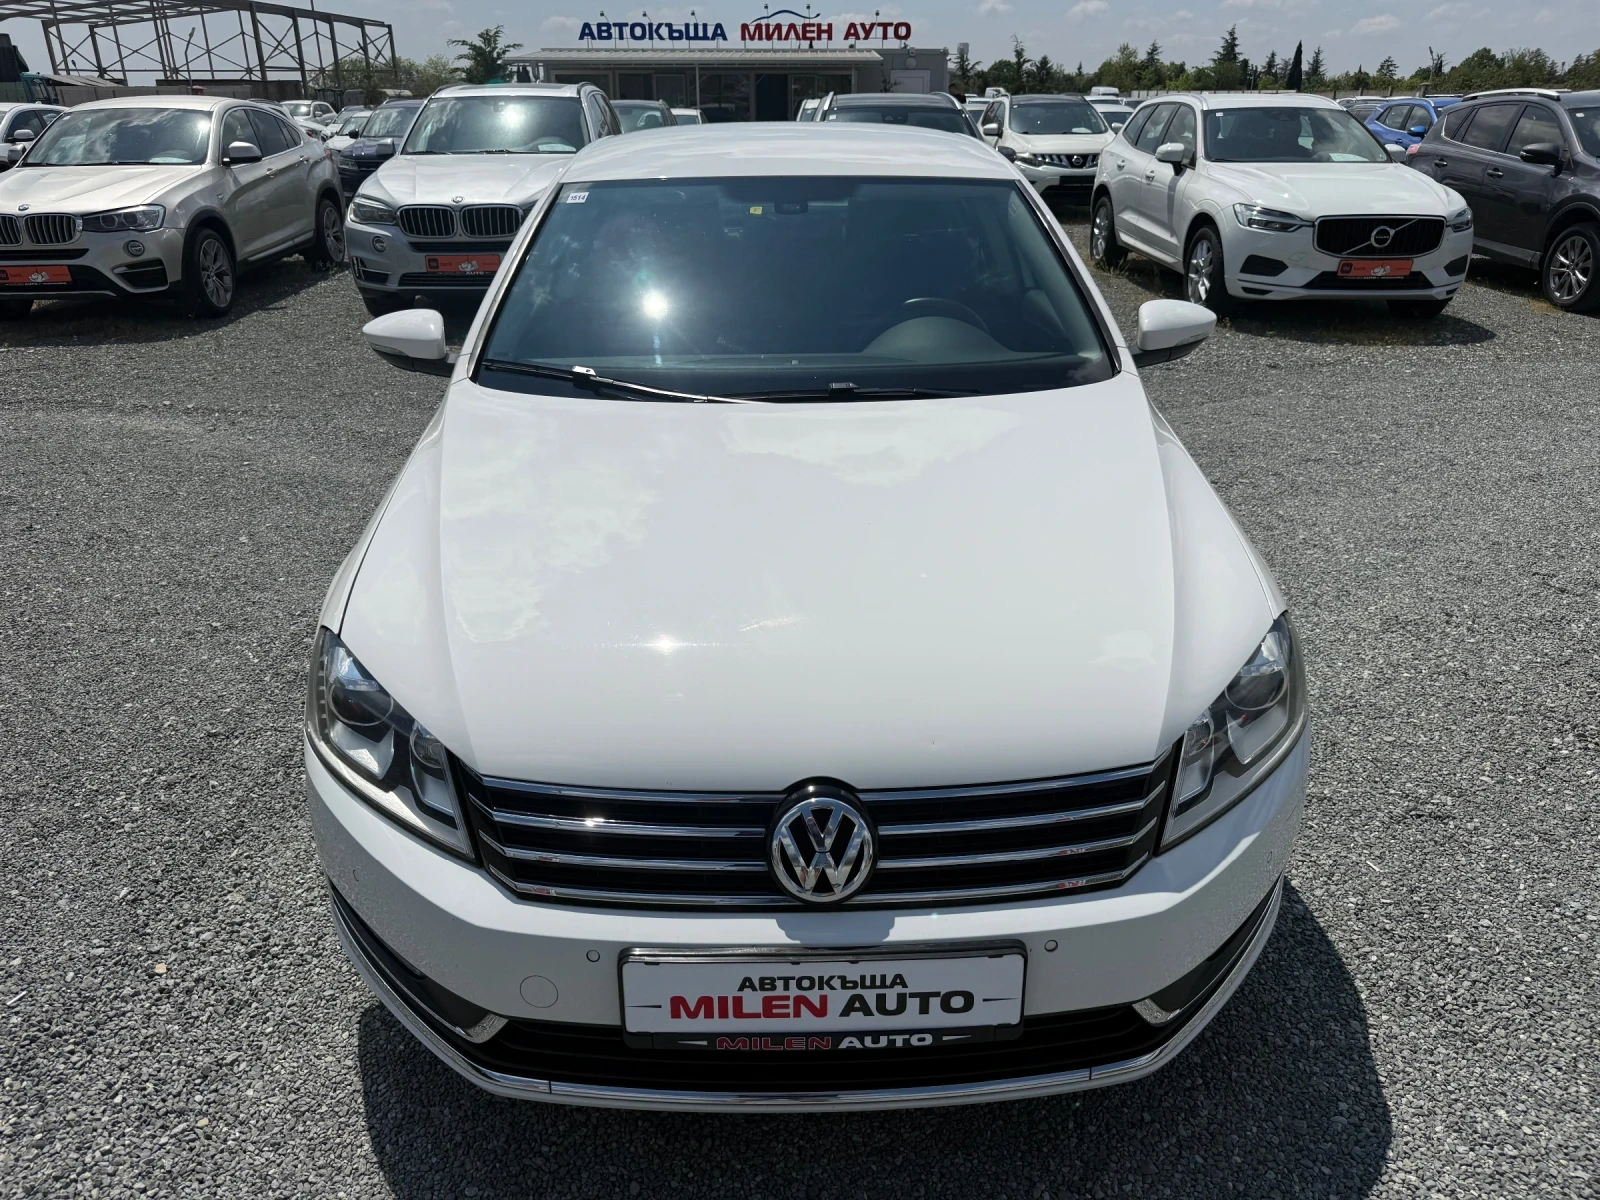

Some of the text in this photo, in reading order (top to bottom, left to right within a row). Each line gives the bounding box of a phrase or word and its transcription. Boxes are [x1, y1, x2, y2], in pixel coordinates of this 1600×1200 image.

[579, 22, 912, 41] АВТОКЪЩА МИЛЕН АУТО
[737, 973, 908, 992] АВТОКЪЩА
[670, 990, 974, 1019] MILEN AUTO
[716, 1033, 933, 1050] MILEN AUTO
